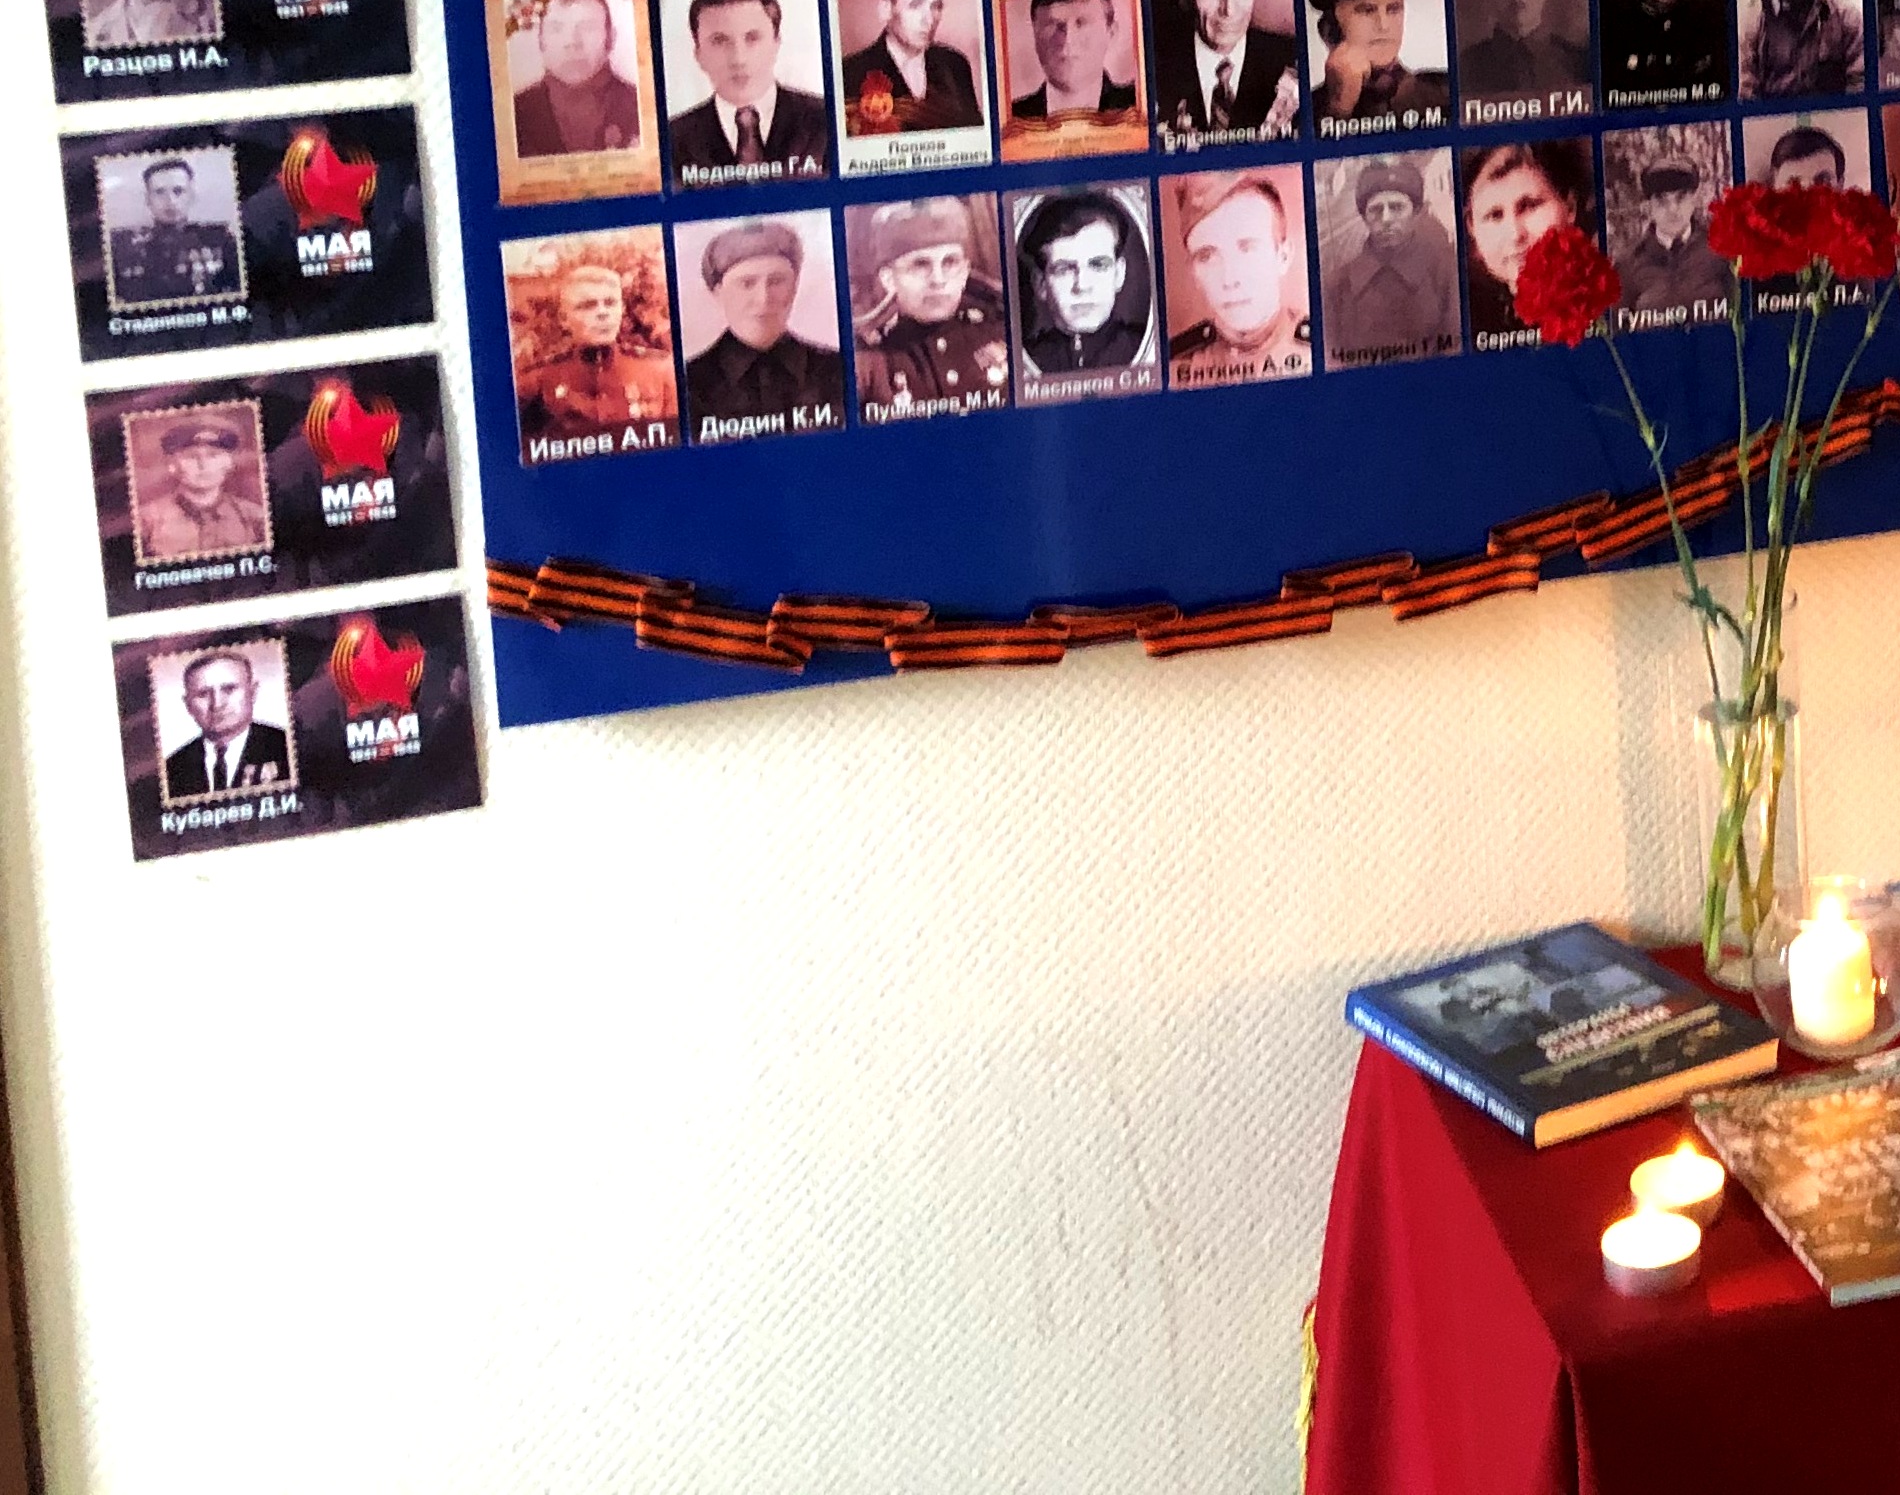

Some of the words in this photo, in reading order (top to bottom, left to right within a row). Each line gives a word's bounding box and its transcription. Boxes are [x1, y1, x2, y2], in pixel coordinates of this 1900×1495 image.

[83, 52, 174, 78] Разцов
[178, 45, 229, 71] И.А.
[1465, 97, 1542, 124] Попов
[1549, 90, 1590, 117] Г.И.
[1320, 110, 1397, 140] Яровой
[682, 160, 783, 185] Медведев
[297, 229, 374, 261] МАЯ
[1617, 305, 1688, 333] Гулько
[1476, 327, 1543, 352] Сергее
[700, 412, 786, 444] Дюдин
[529, 432, 614, 463] Ивлев
[321, 476, 395, 511] МАЯ
[346, 712, 421, 748] МАЯ
[161, 803, 254, 835] Кубарев
